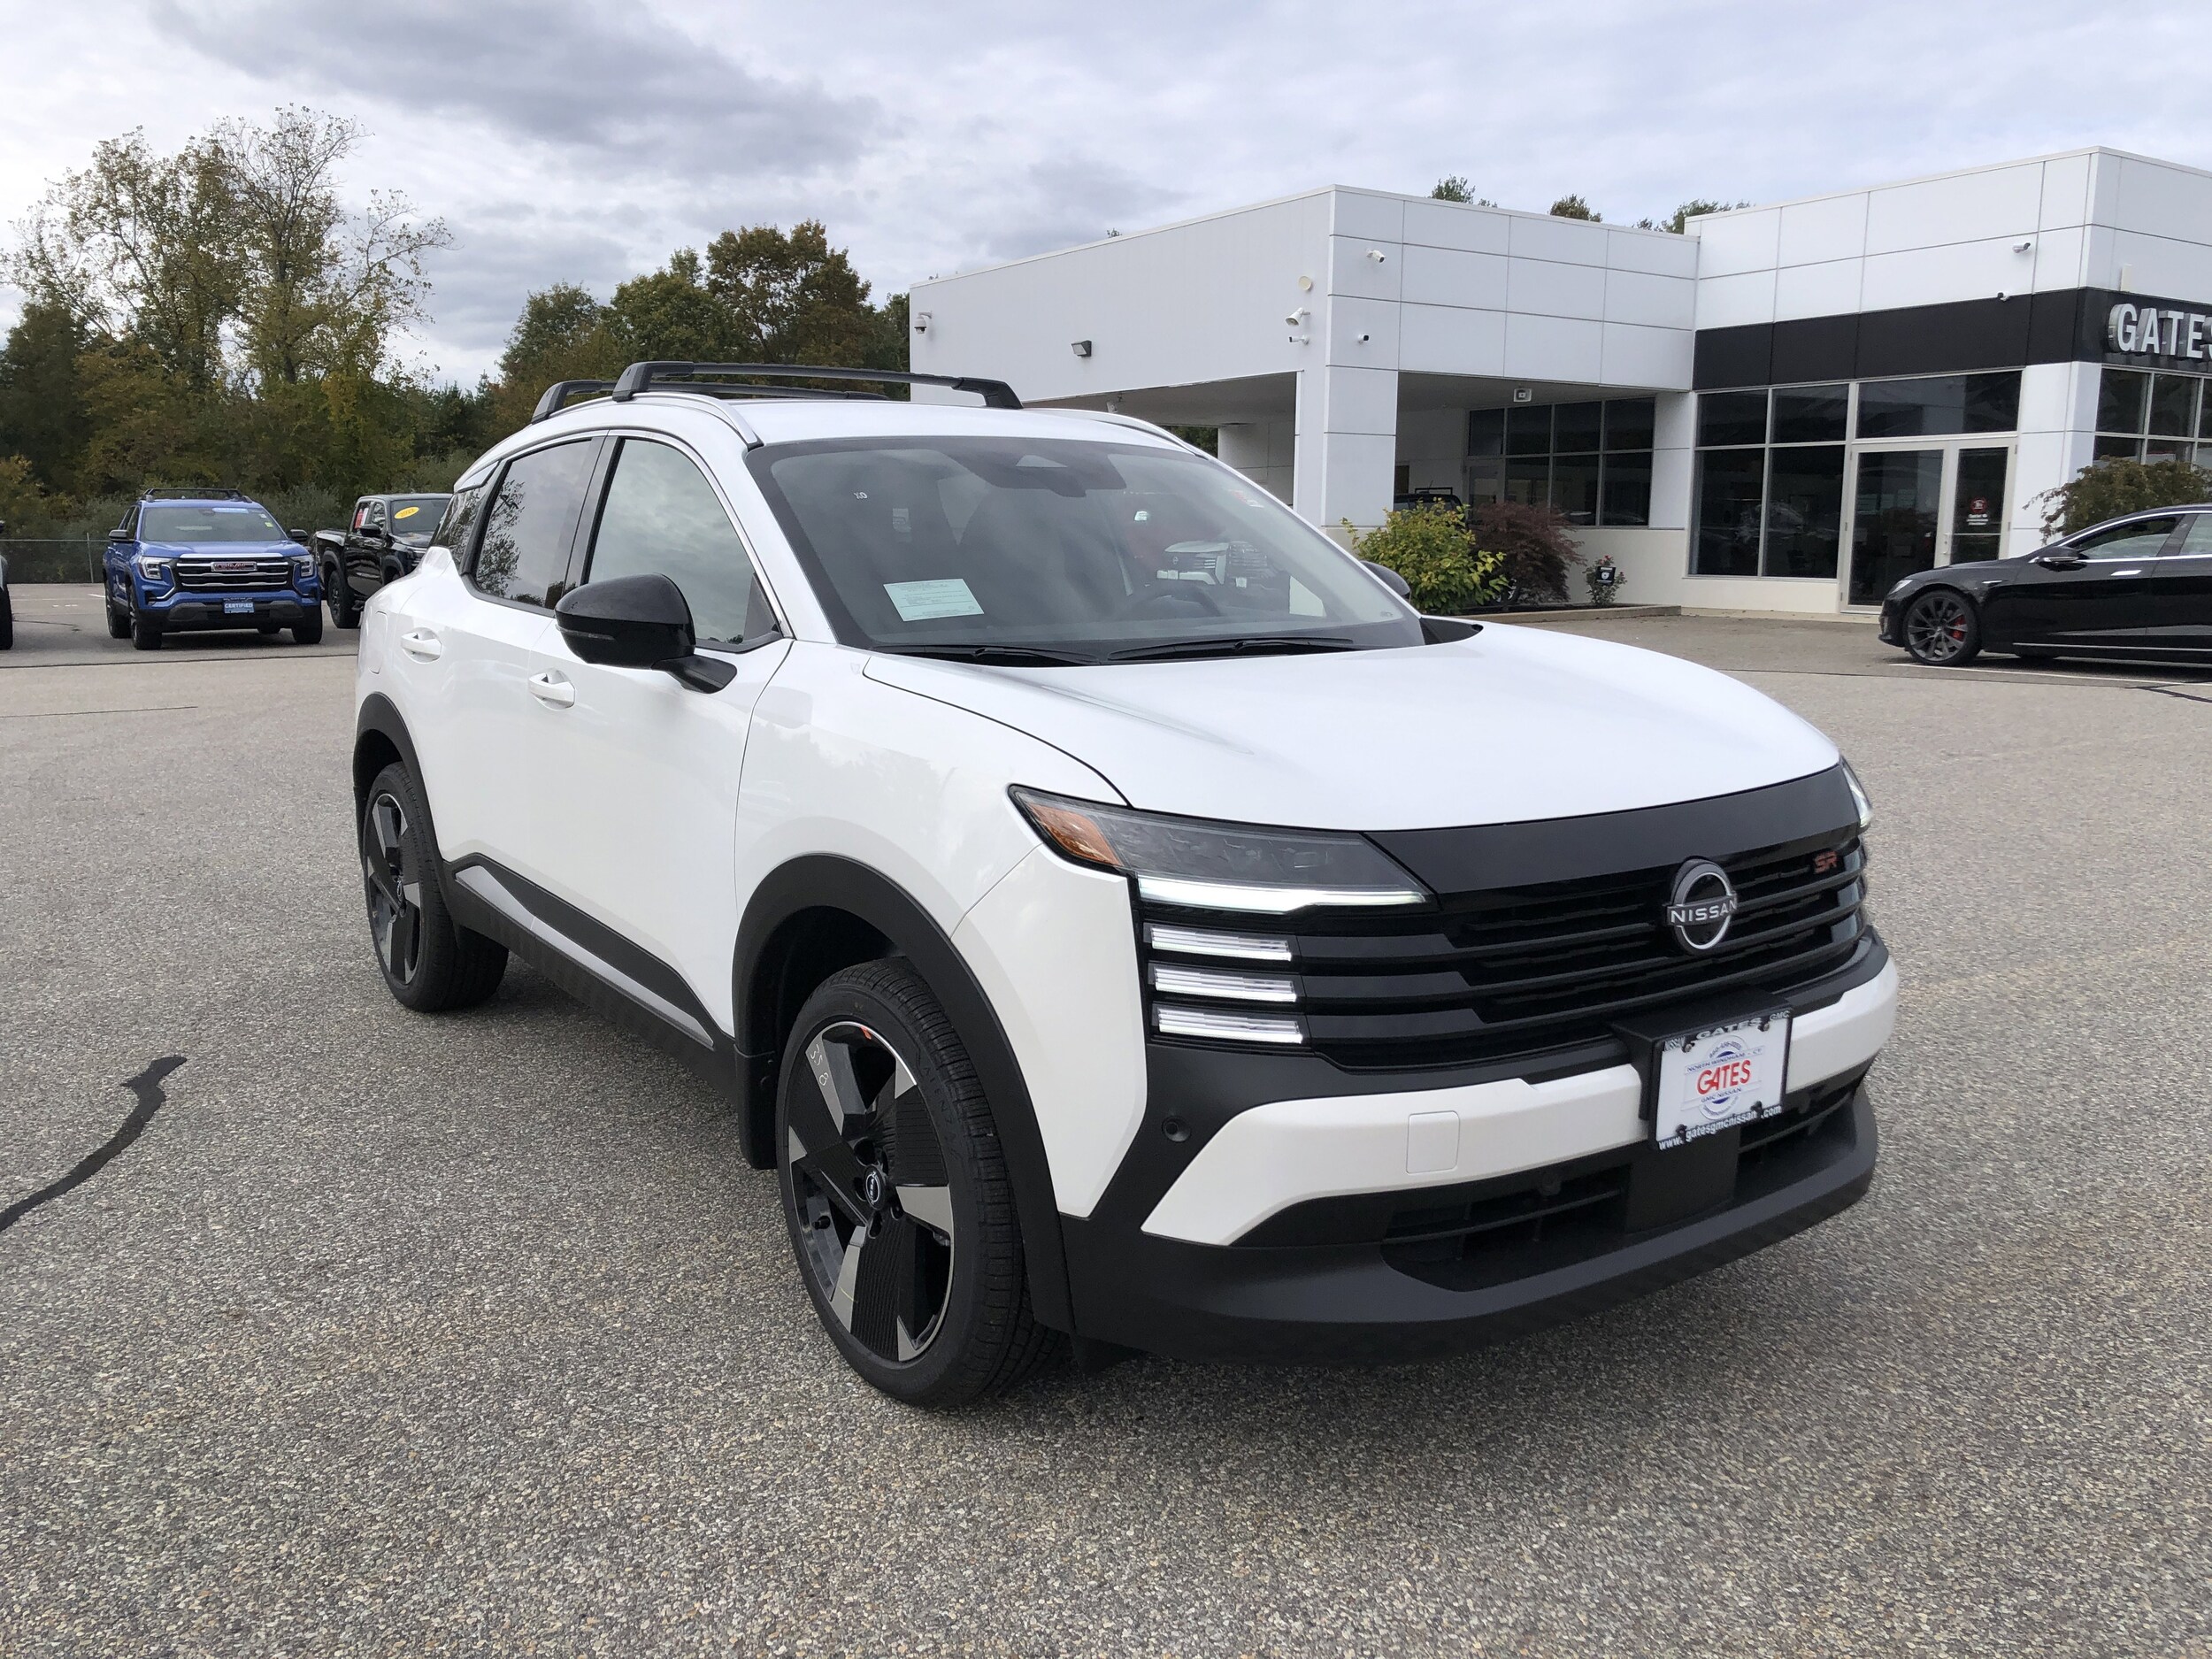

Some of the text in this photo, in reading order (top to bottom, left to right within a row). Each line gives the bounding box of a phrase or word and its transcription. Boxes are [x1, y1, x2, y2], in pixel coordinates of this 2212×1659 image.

[2108, 303, 2212, 359] GATE
[1671, 899, 1738, 924] NISSAN
[1696, 1018, 1762, 1040] GATES
[1770, 1010, 1791, 1022] GMC
[1686, 1061, 1710, 1072] NORTH
[1711, 1052, 1746, 1065] WINDHAM
[1697, 1059, 1751, 1094] GATES
[1701, 1087, 1741, 1103] GMC NISSAN
